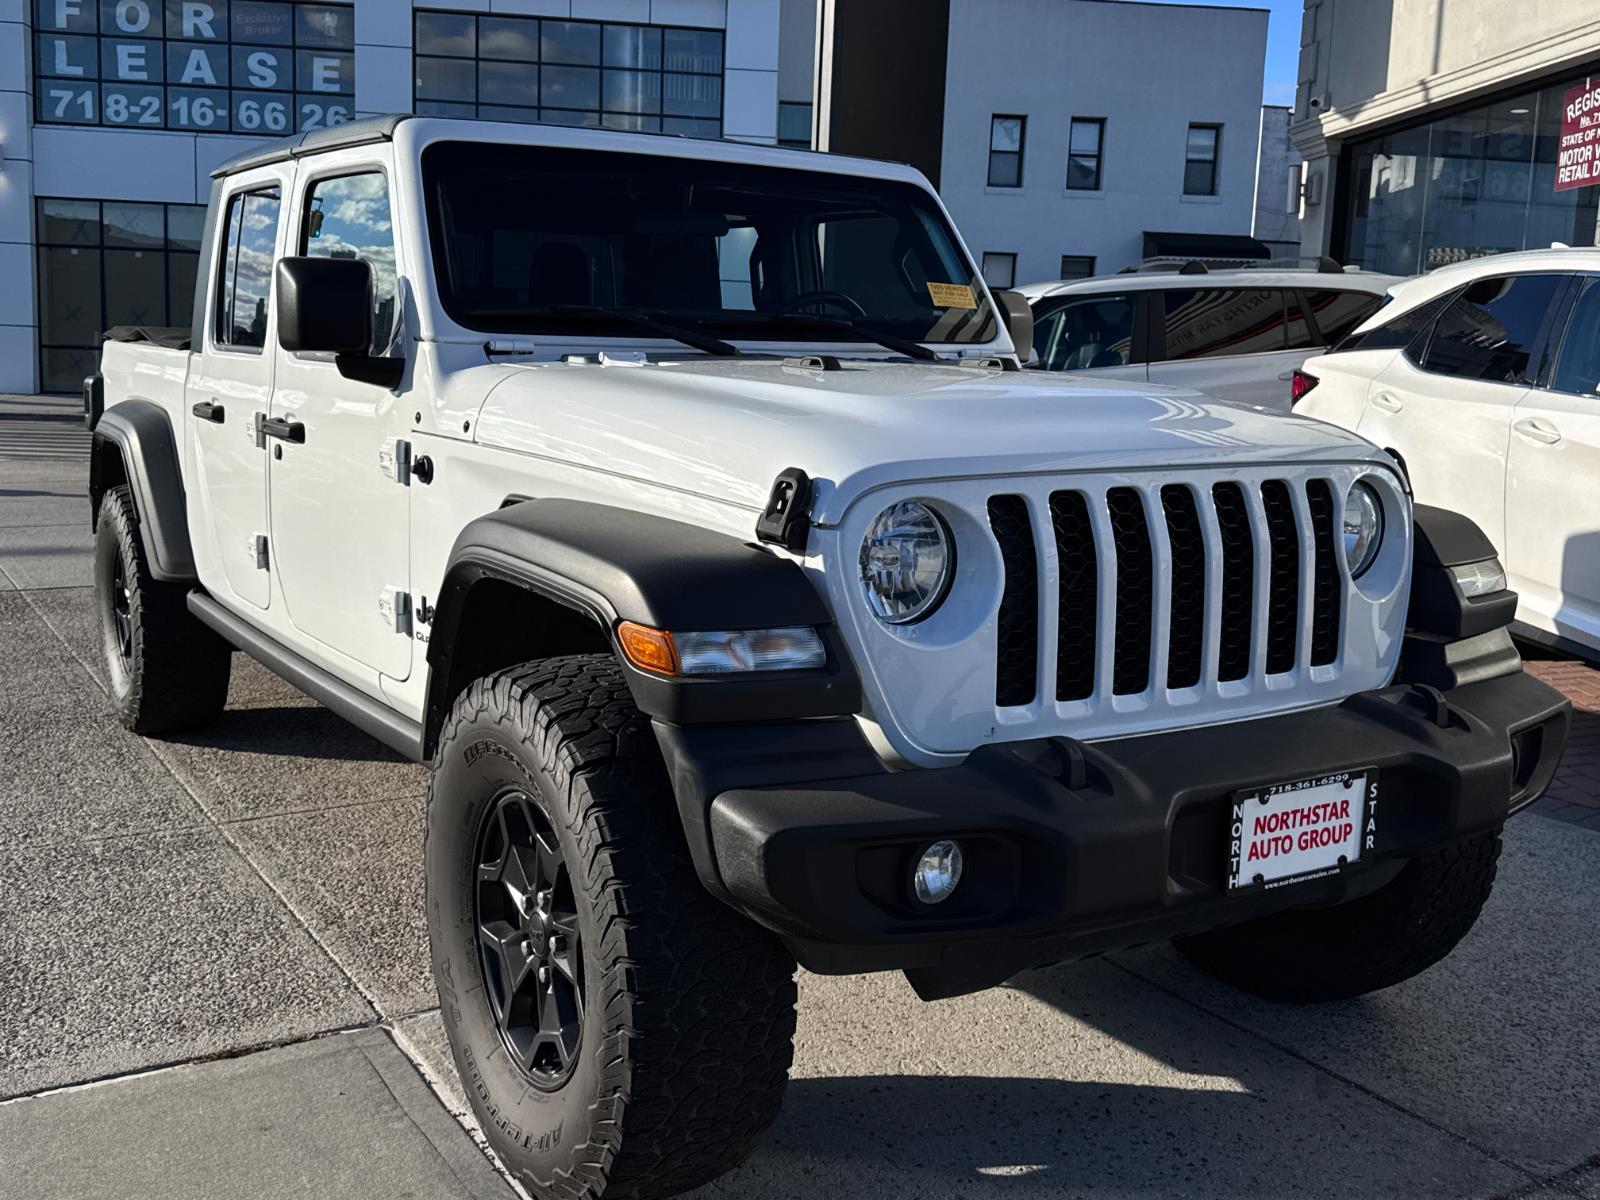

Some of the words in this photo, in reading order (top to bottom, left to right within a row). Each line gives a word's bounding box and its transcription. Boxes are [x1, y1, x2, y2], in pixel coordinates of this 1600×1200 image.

[55, 0, 216, 39] FOR
[245, 24, 282, 35] Broker
[55, 40, 341, 92] LEASE
[1559, 145, 1593, 167] MOTOR
[1562, 132, 1583, 147] STATE
[1585, 129, 1596, 142] OF
[1559, 163, 1591, 183] RETAIL
[1269, 773, 1350, 795] 718-361-6299
[1253, 799, 1350, 836] NORTHSTAR
[1366, 783, 1378, 850] STAR
[1228, 804, 1243, 890] NORTH
[1248, 834, 1293, 862] AUTO
[1297, 823, 1353, 851] GROUP
